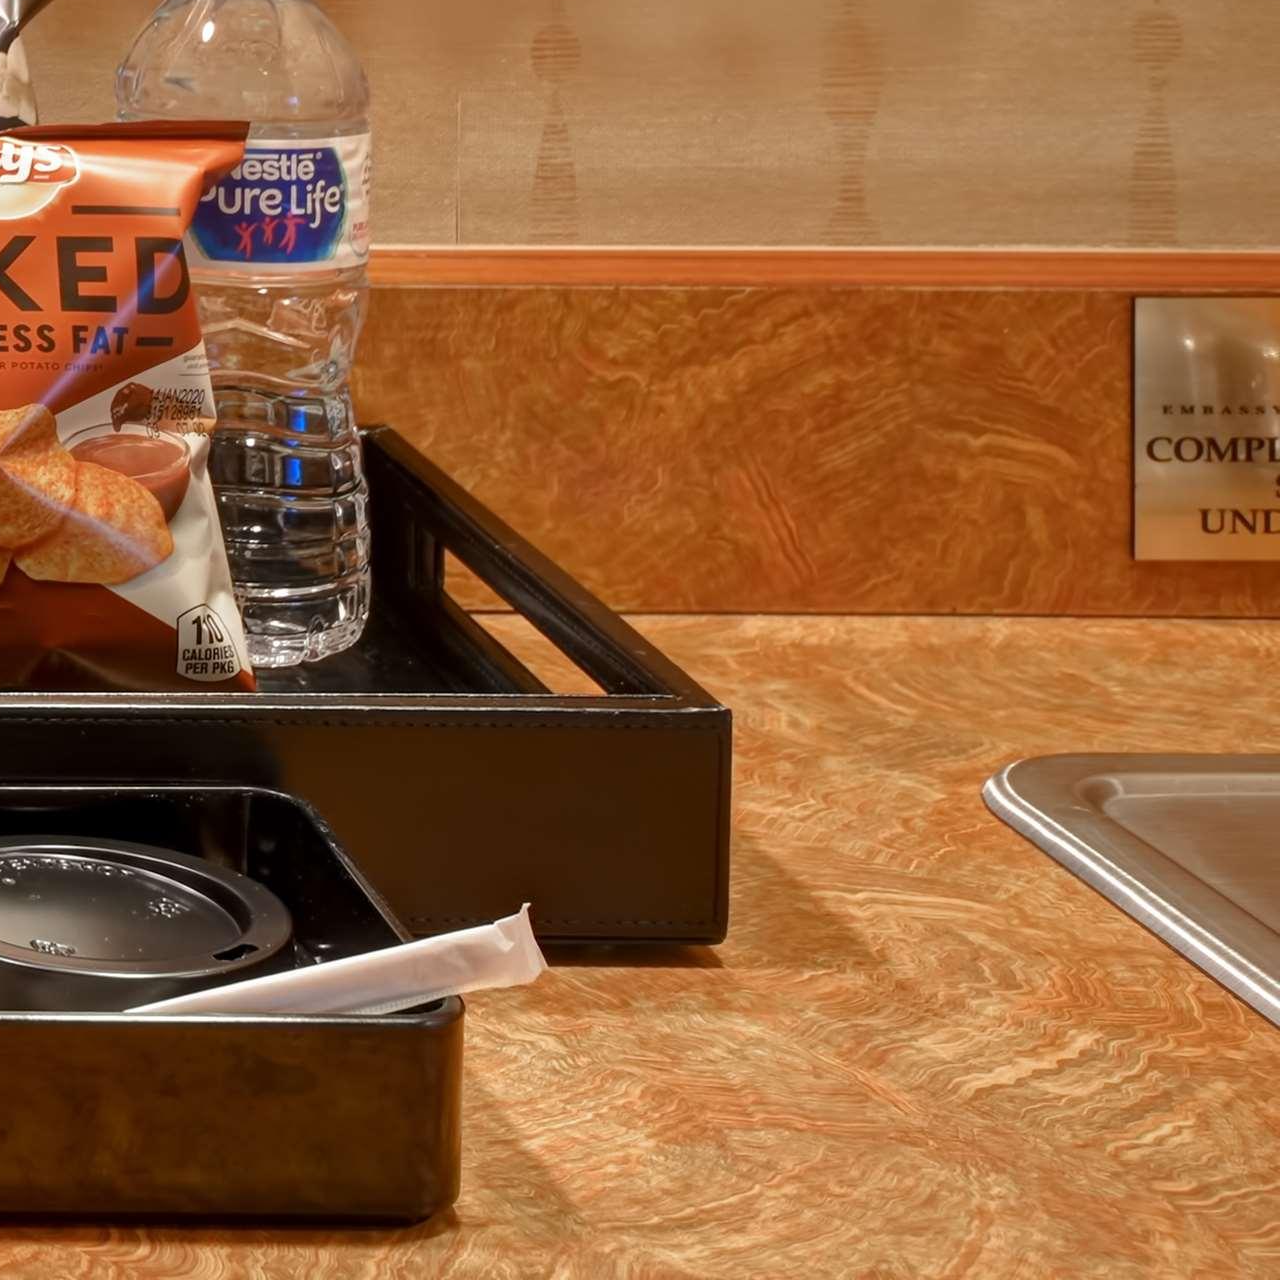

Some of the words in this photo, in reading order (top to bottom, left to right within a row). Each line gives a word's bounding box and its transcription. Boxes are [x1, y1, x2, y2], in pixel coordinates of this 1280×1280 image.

[201, 184, 283, 215] ure
[291, 179, 341, 229] Life
[72, 324, 129, 356] FAT
[11, 361, 61, 371] POTATO
[182, 644, 235, 662] CALORIES
[185, 662, 209, 675] PER
[211, 660, 235, 675] PKG
